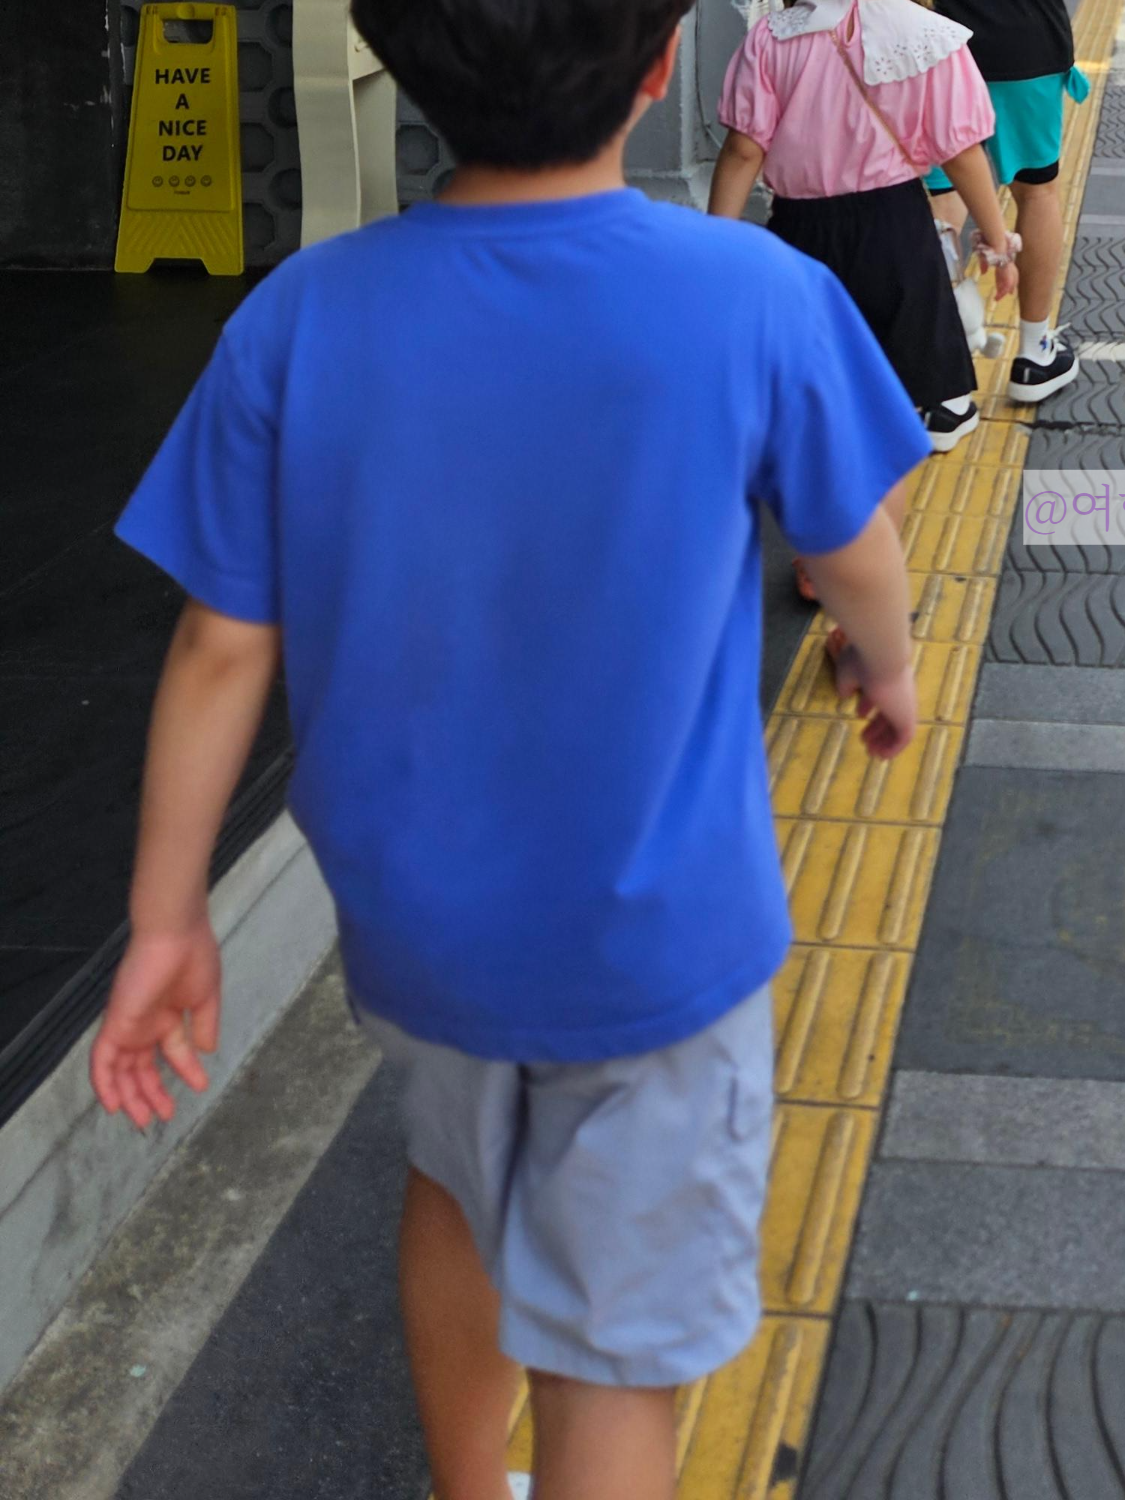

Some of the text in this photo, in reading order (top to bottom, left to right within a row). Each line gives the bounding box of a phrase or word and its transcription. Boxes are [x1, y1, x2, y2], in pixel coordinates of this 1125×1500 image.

[155, 67, 211, 85] HAVE
[175, 93, 190, 110] A
[158, 119, 207, 136] NICE
[162, 145, 204, 162] DAY
